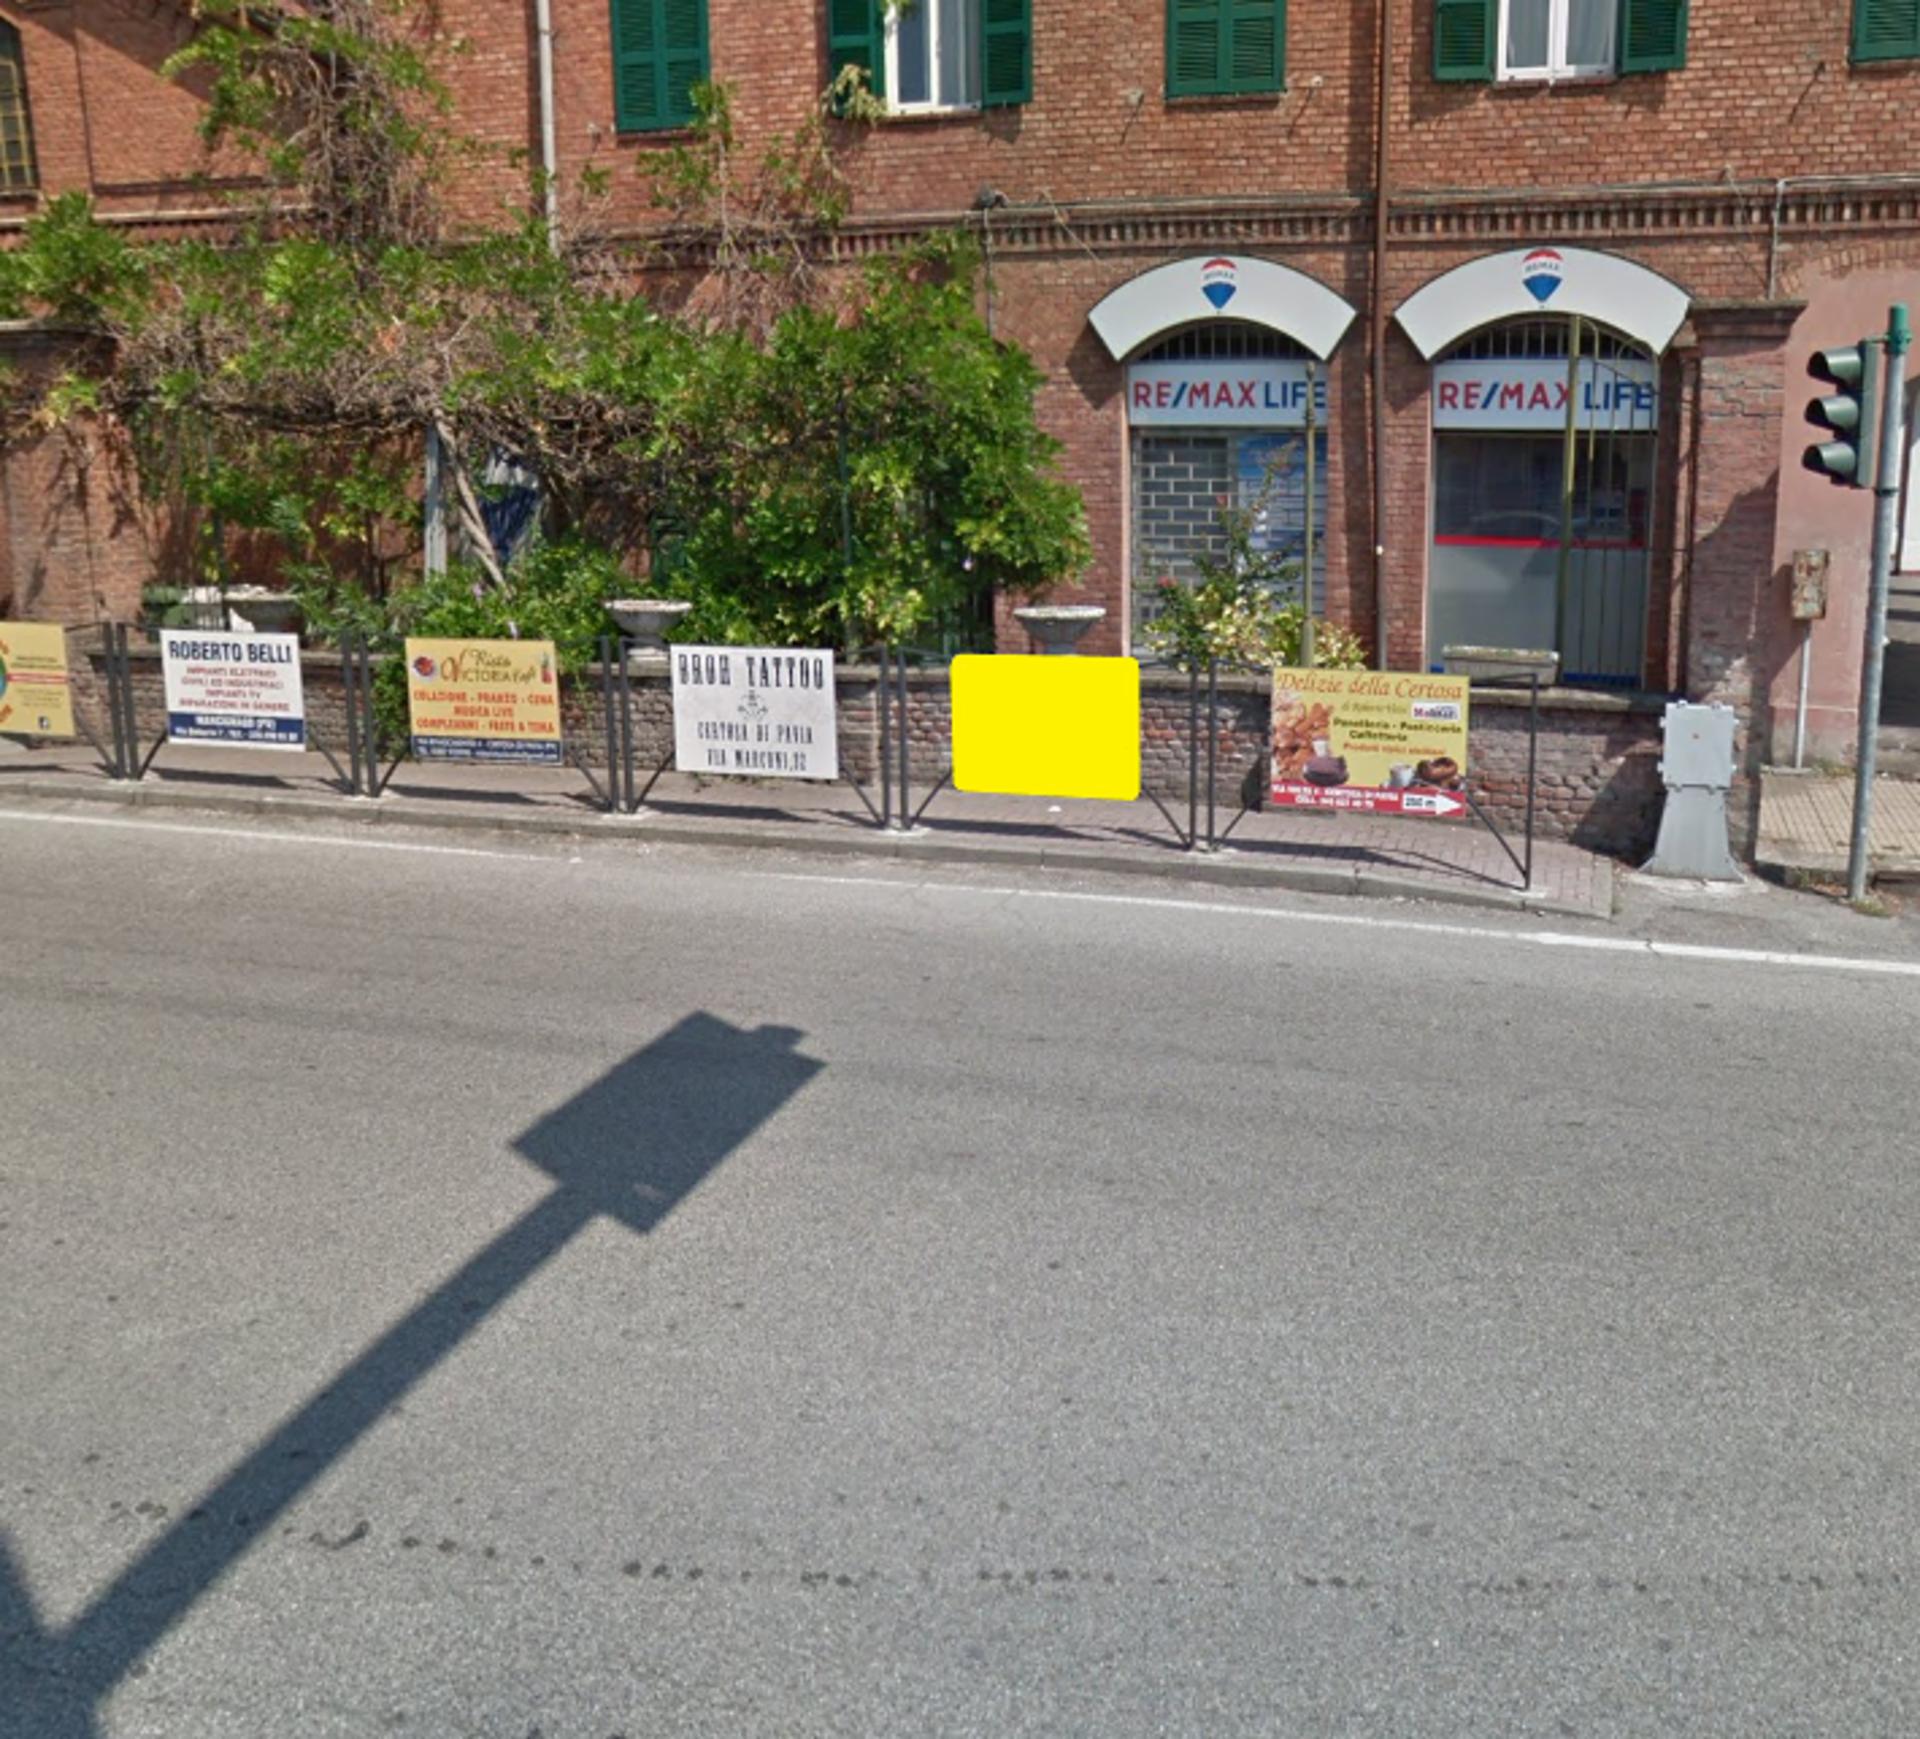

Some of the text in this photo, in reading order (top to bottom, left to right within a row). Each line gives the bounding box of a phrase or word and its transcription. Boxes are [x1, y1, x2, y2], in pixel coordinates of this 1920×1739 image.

[1134, 380, 1326, 409] RE/MAX LIFE
[1439, 381, 1653, 410] RE/MAX LIFE
[168, 640, 292, 663] ROBERTO BELLI
[746, 656, 824, 689] TATTOO
[1277, 671, 1462, 700] Delizie della Certosa
[414, 690, 467, 701] COLAZIONE
[478, 692, 517, 703] PRANZO
[528, 693, 554, 705] CENA
[454, 705, 514, 717] MUSICA LIVE
